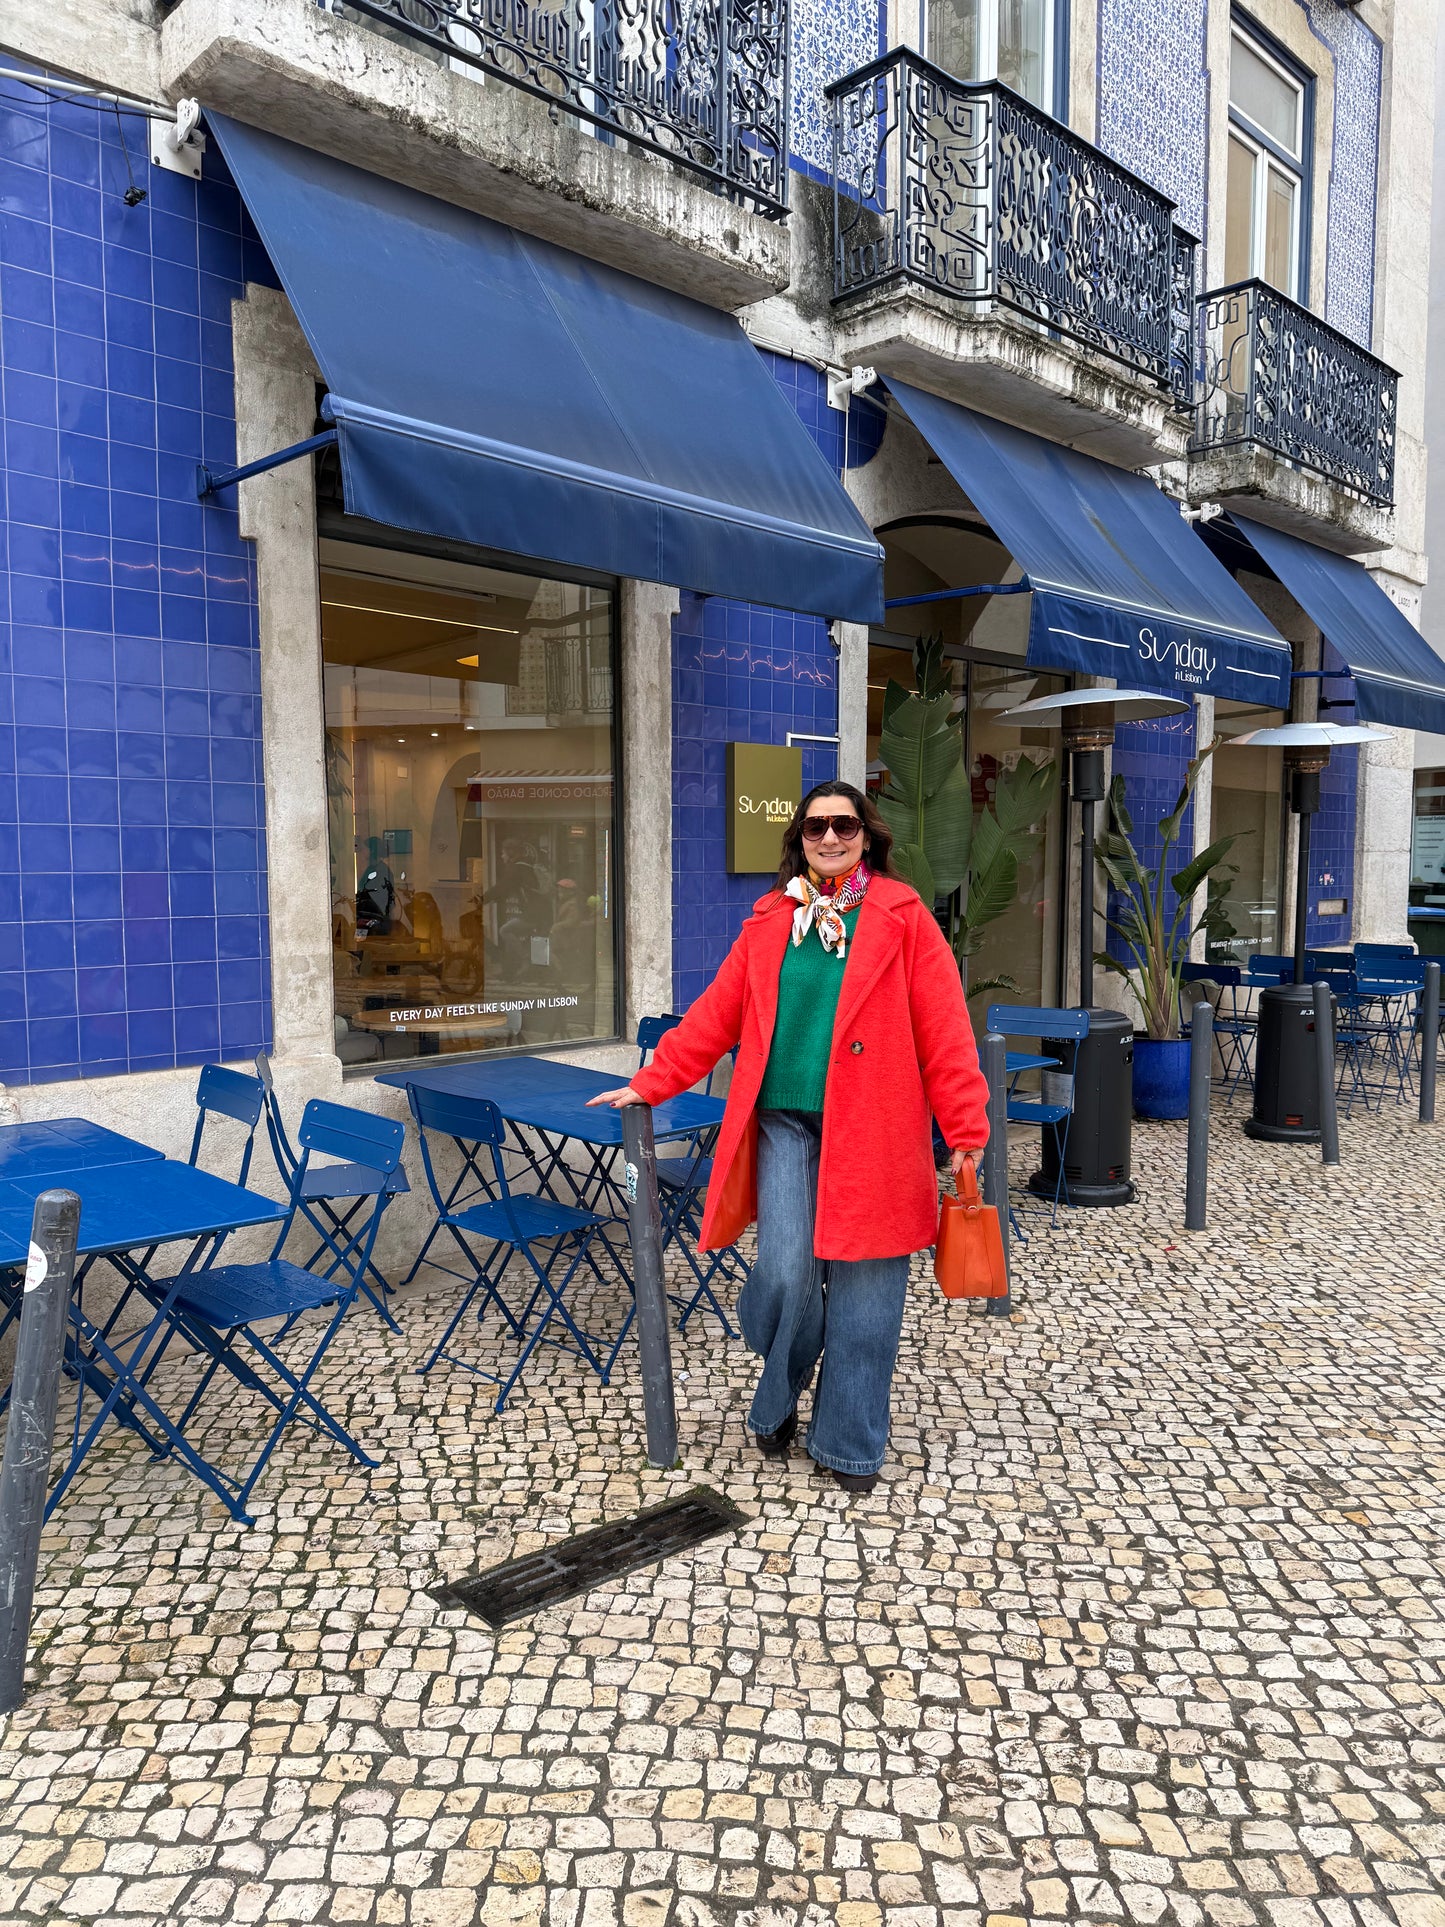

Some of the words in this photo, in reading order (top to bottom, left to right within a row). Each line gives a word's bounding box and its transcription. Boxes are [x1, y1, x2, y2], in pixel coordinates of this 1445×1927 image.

[1139, 628, 1216, 681] Sunday
[738, 795, 798, 820] Sunday
[390, 1009, 422, 1022] EVERY
[424, 1007, 444, 1019] DAY
[446, 1004, 475, 1017] FEELS
[477, 1002, 498, 1014] LIKE
[500, 999, 535, 1012] SUNDAY
[536, 998, 546, 1009] IN
[548, 996, 578, 1008] LISBON
